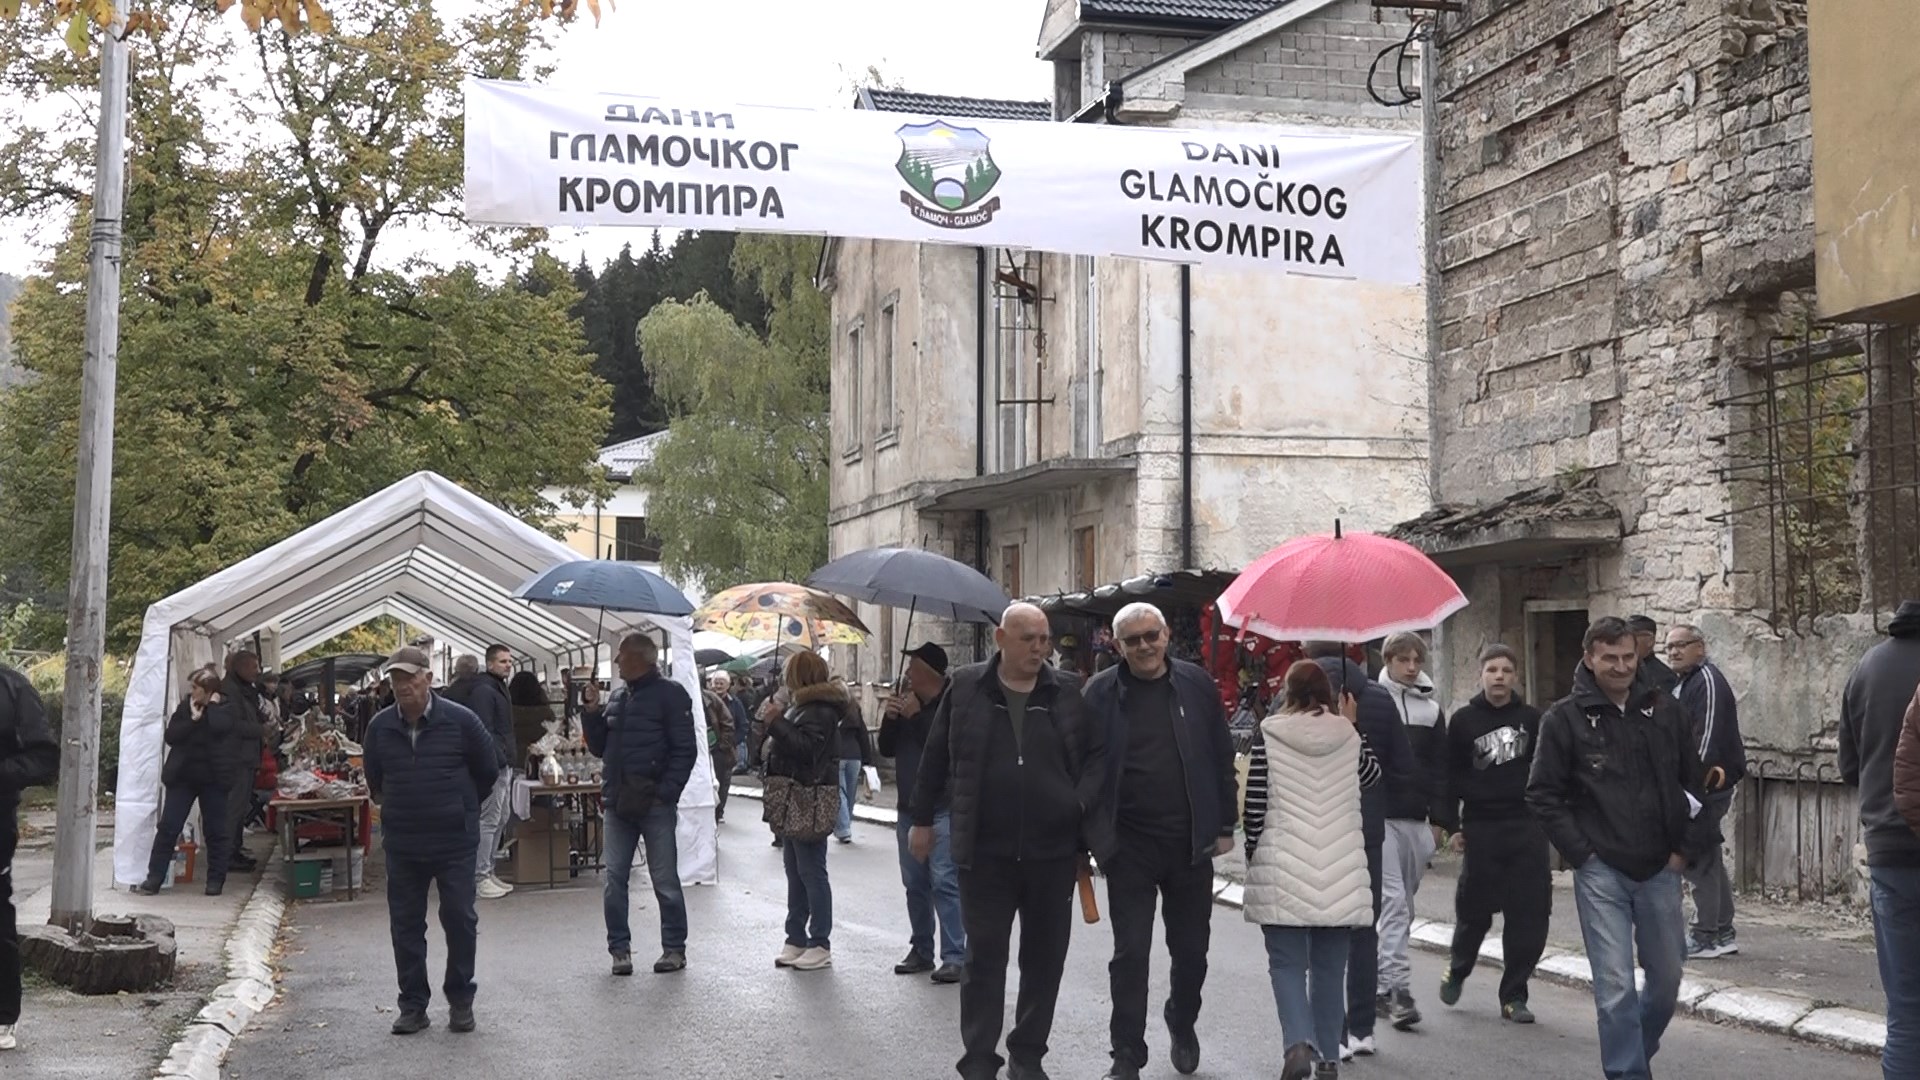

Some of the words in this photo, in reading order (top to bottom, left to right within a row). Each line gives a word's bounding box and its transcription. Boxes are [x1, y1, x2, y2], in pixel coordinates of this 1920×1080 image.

[604, 104, 735, 129] ДАНИ
[550, 131, 799, 171] ГЛАМОЧКОГ
[1181, 141, 1280, 168] DANI
[559, 176, 785, 219] КРОМПИРА
[1120, 169, 1347, 219] GLAMOČKOG
[1141, 214, 1345, 267] KROMPIRA
